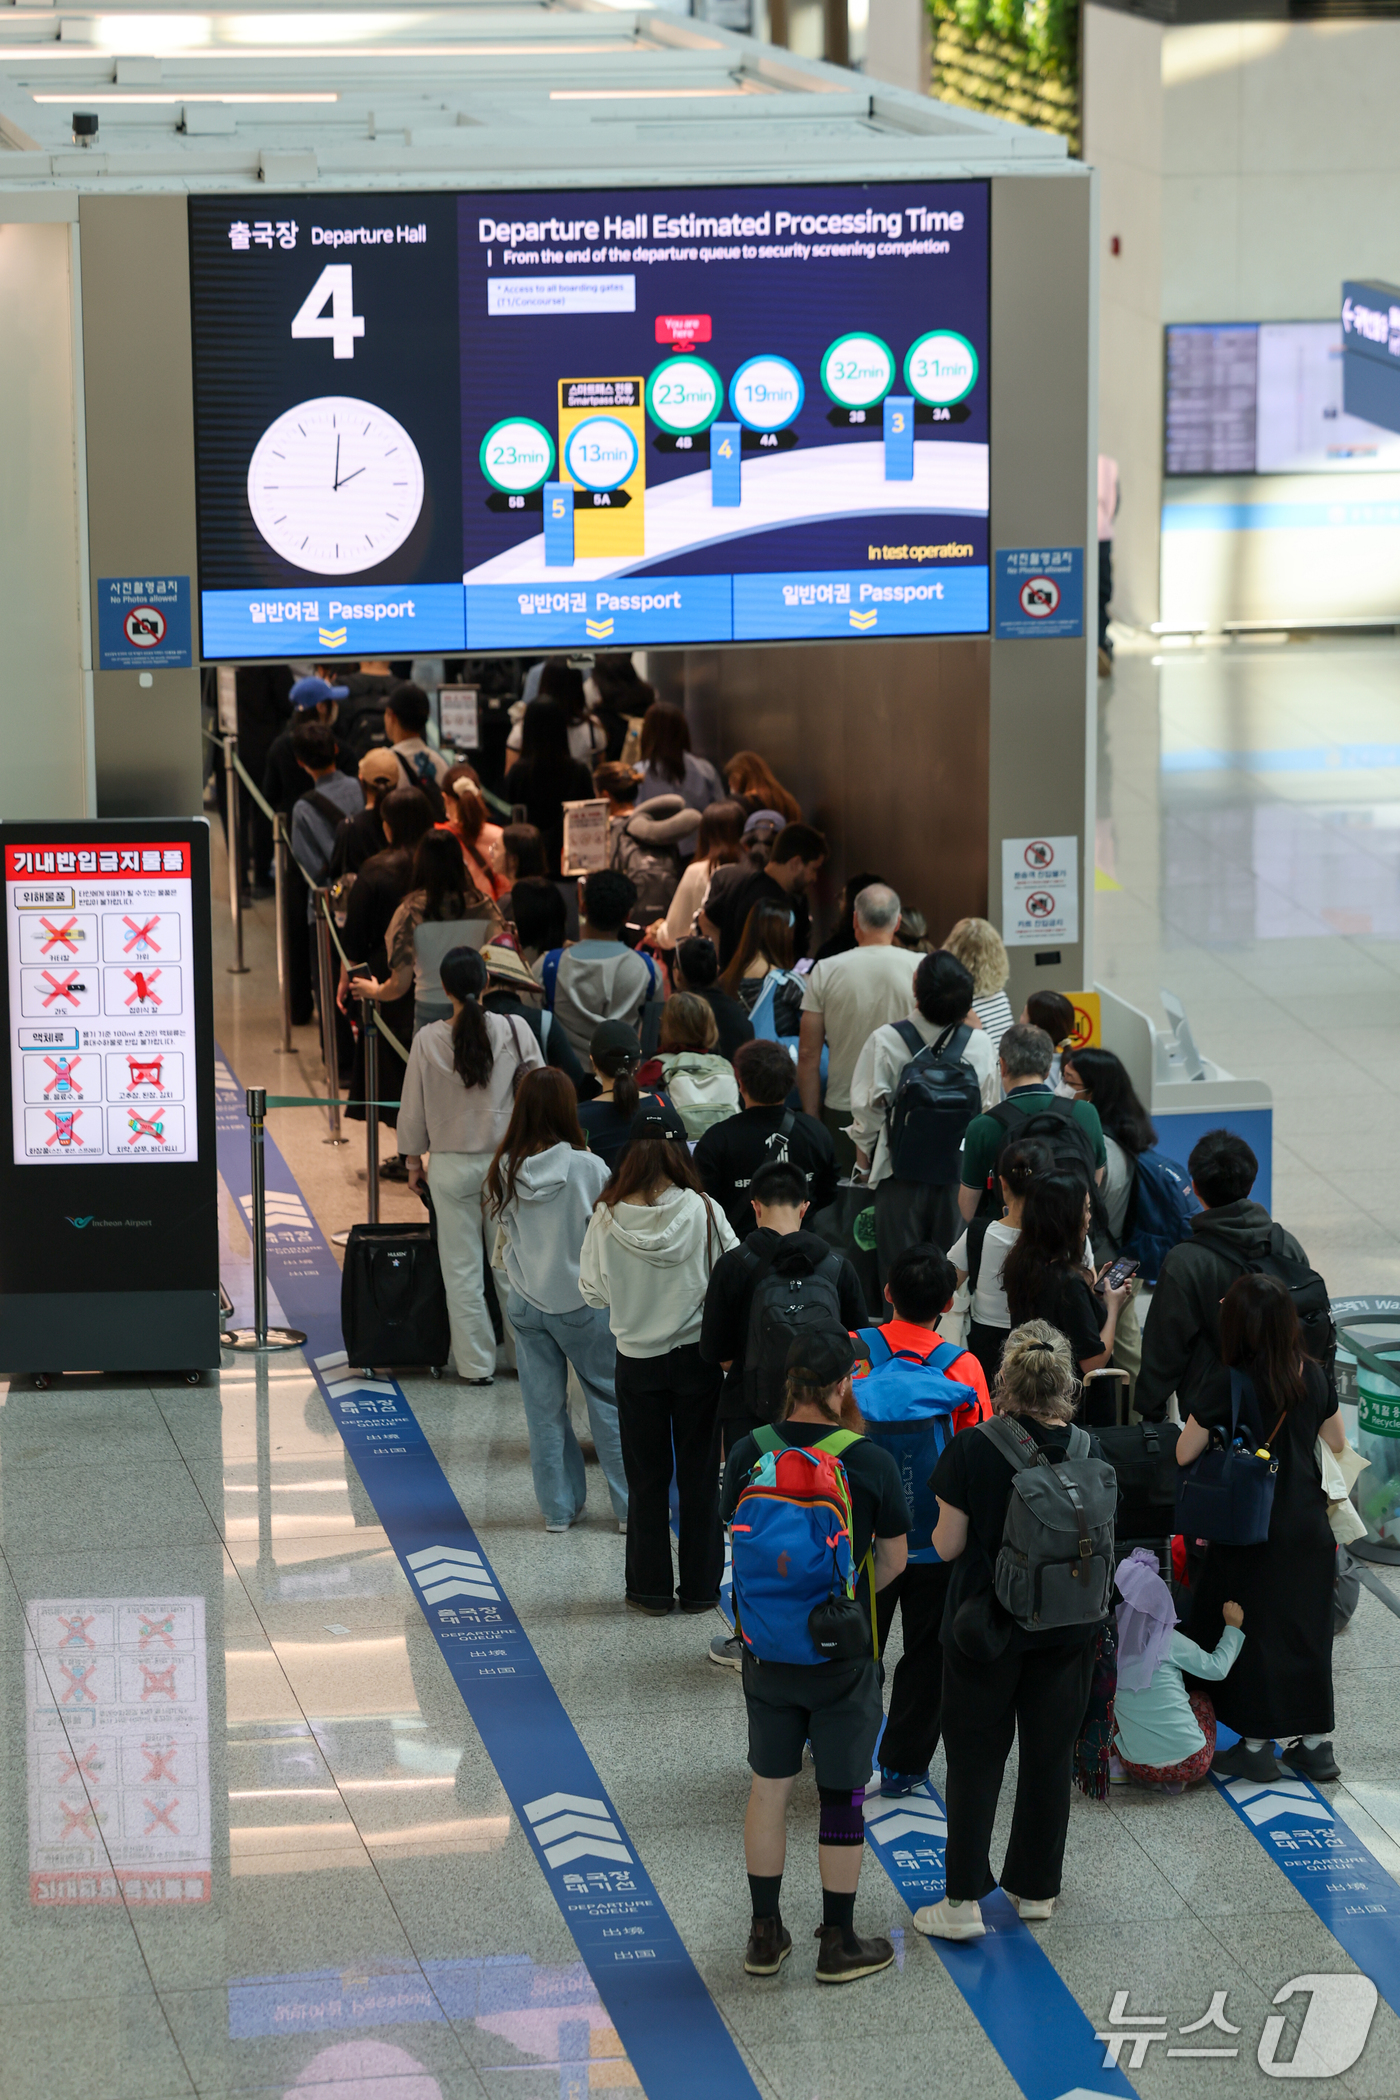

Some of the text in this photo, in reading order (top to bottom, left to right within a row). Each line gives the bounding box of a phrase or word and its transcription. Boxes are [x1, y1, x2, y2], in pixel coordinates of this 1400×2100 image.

[228, 220, 427, 250] 출국장 Departure Hall
[478, 206, 964, 248] Departure Hall Estimated Processing Time
[503, 238, 950, 265] From the end of the departure queue to security screening completion
[291, 263, 365, 359] 4
[834, 361, 884, 380] 32min
[917, 359, 967, 378] 31min
[658, 384, 712, 406] 23min
[744, 384, 793, 403] 19min
[849, 410, 866, 424] 3B
[932, 407, 951, 421] 3A
[891, 412, 904, 433] 3
[675, 436, 693, 449] 4B
[760, 433, 778, 447] 4A
[493, 446, 544, 465] 23min
[578, 444, 628, 463] 13min
[717, 440, 732, 459] 4
[507, 495, 525, 509] 5B
[551, 498, 565, 518] 5
[593, 493, 611, 507] 5A
[868, 541, 974, 563] In test operation
[110, 594, 178, 604] No Photos allowed
[783, 582, 944, 605] 일반여권 Passport
[518, 592, 681, 614] 일반여권 Passport
[249, 600, 415, 623] 일반여권 Passport
[13, 850, 184, 873] 기내반입금지물품
[92, 1218, 152, 1228] Incheon Airport
[441, 1629, 517, 1638] DEPARTURE
[1269, 1828, 1336, 1841] 출국장
[1275, 1838, 1347, 1850] 대기선
[896, 1859, 943, 1870] 대기
[1284, 1857, 1368, 1867] DEPARTURE
[1306, 1863, 1355, 1871] QUEUE
[563, 1871, 631, 1884] 출국장
[566, 1881, 637, 1893] 대기선
[568, 1900, 654, 1911] DEPARTURE
[589, 1907, 639, 1916] QUEUE
